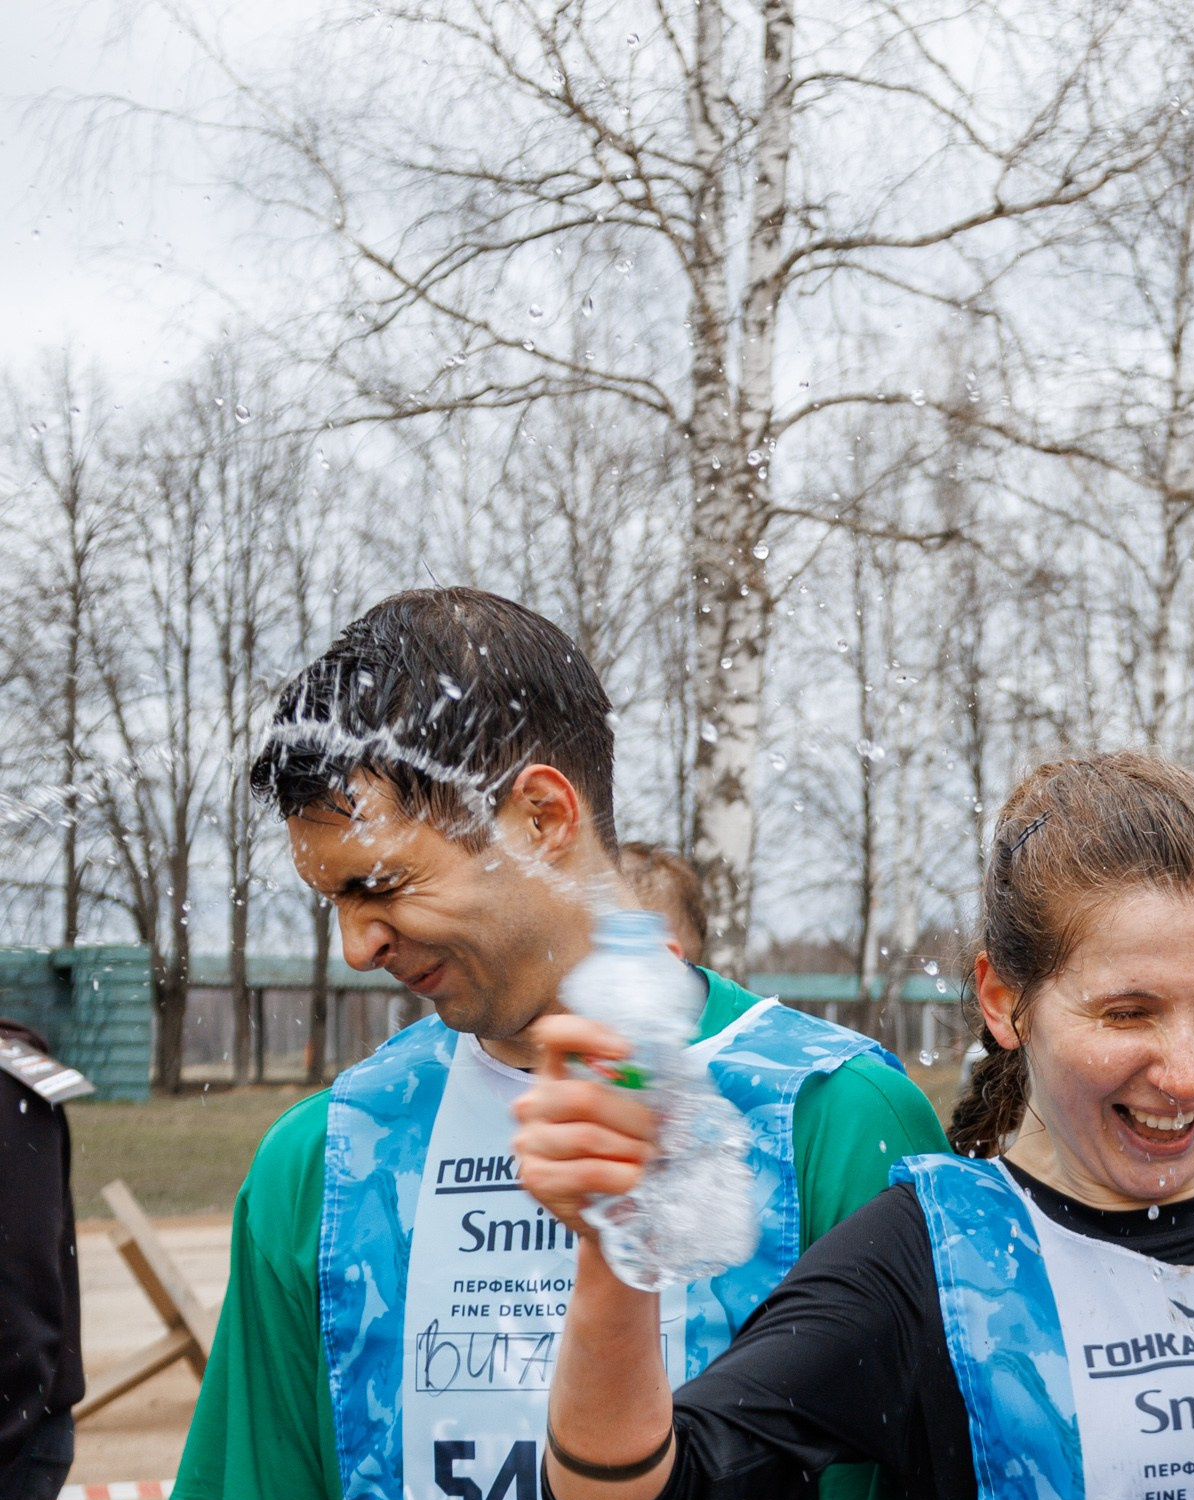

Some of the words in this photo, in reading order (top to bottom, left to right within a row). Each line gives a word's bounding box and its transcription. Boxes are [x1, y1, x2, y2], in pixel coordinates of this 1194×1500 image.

[458, 1207, 574, 1253] Smin
[451, 1304, 490, 1317] FINE
[499, 1303, 567, 1316] DEVELO
